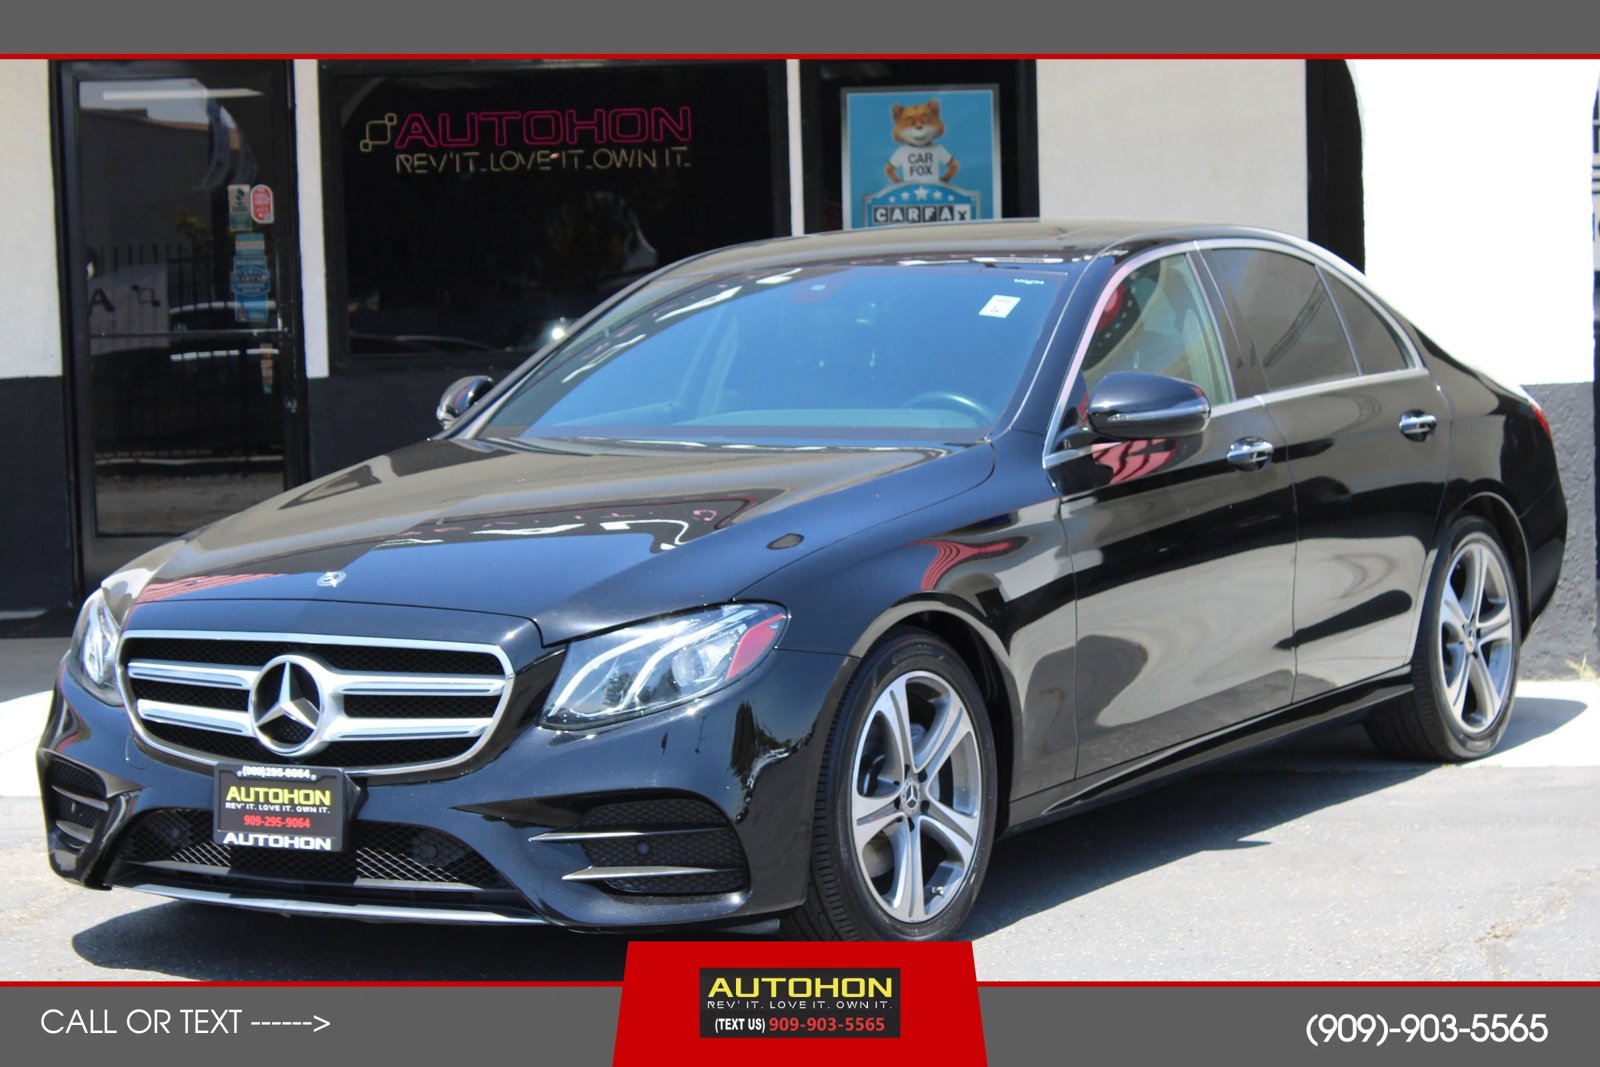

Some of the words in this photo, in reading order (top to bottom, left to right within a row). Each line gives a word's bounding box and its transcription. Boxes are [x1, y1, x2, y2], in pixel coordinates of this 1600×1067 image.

[395, 106, 692, 148] AUTOHON
[490, 150, 552, 172] LOVE
[593, 148, 657, 170] OWN
[907, 153, 934, 164] CAR
[909, 166, 933, 177] FOX
[874, 206, 968, 222] CARFAX
[225, 785, 331, 806] AUTOHON
[259, 804, 280, 812] LOVE
[295, 806, 317, 814] OWN
[243, 814, 311, 829] 909-295-9064
[222, 832, 331, 851] AUTOHON
